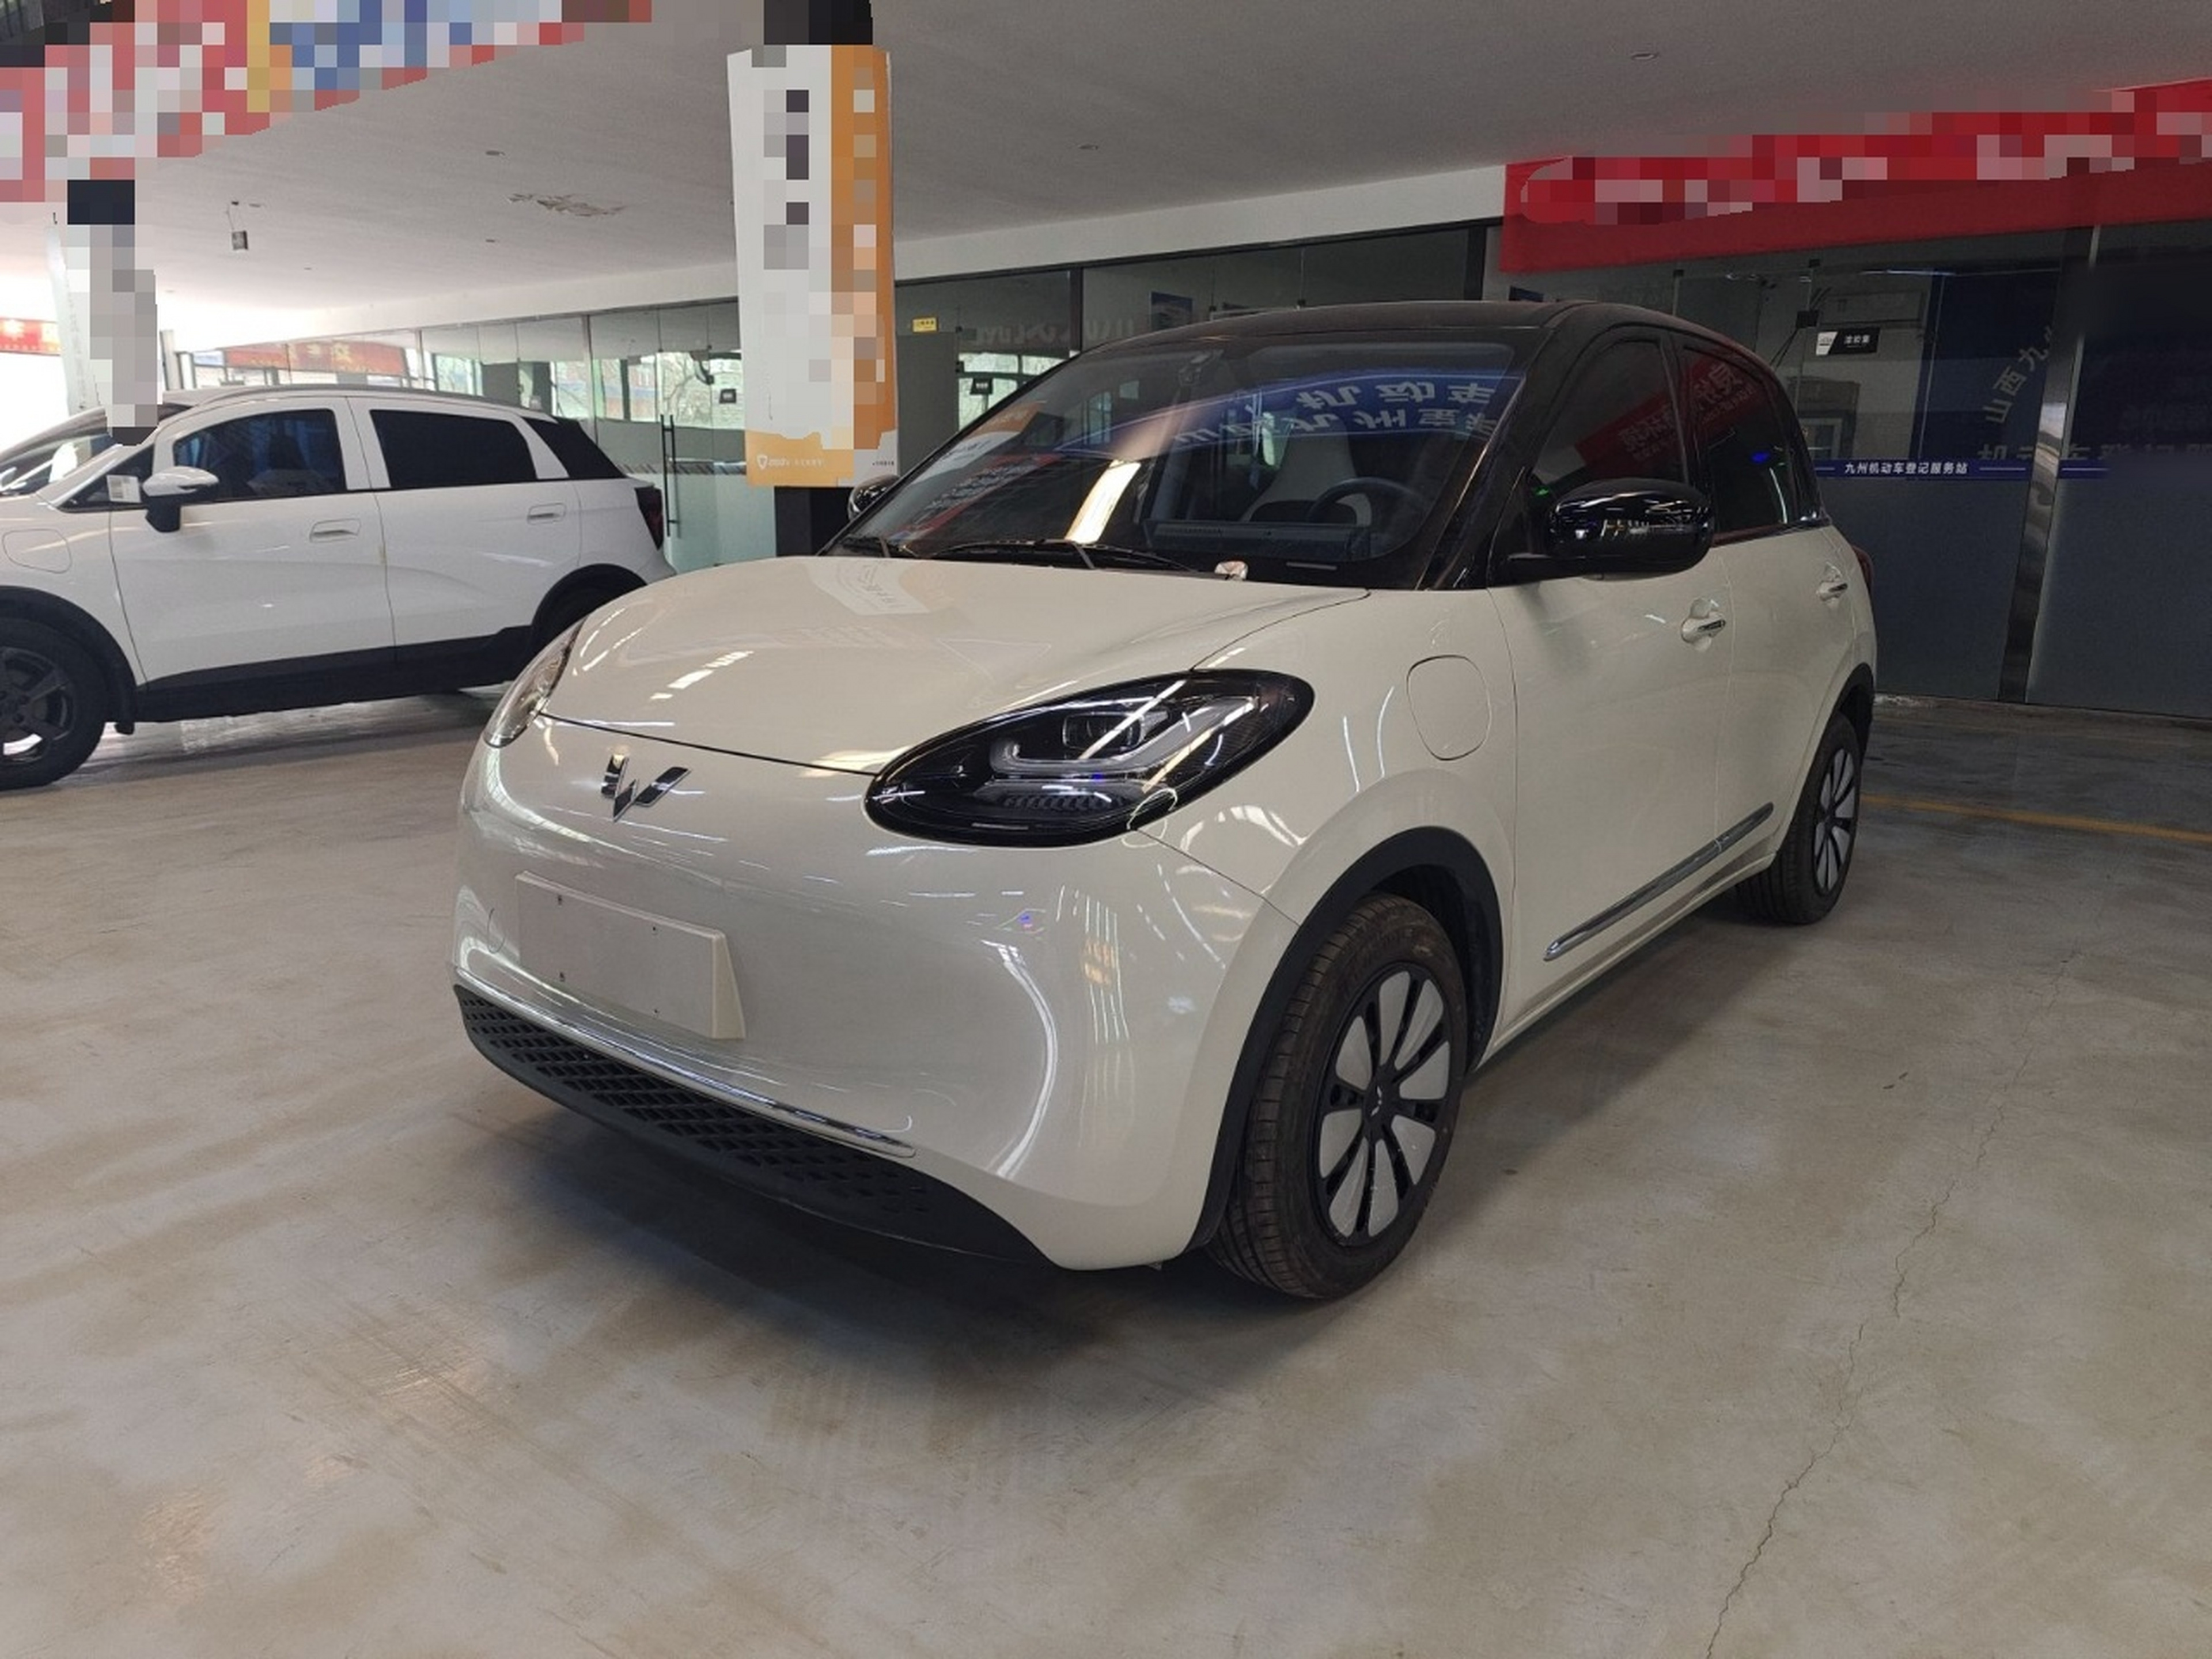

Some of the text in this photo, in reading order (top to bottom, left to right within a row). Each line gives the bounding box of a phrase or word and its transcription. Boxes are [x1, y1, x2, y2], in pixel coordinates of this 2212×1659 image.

[1844, 461, 1968, 475] 九州机动车登记服务站
